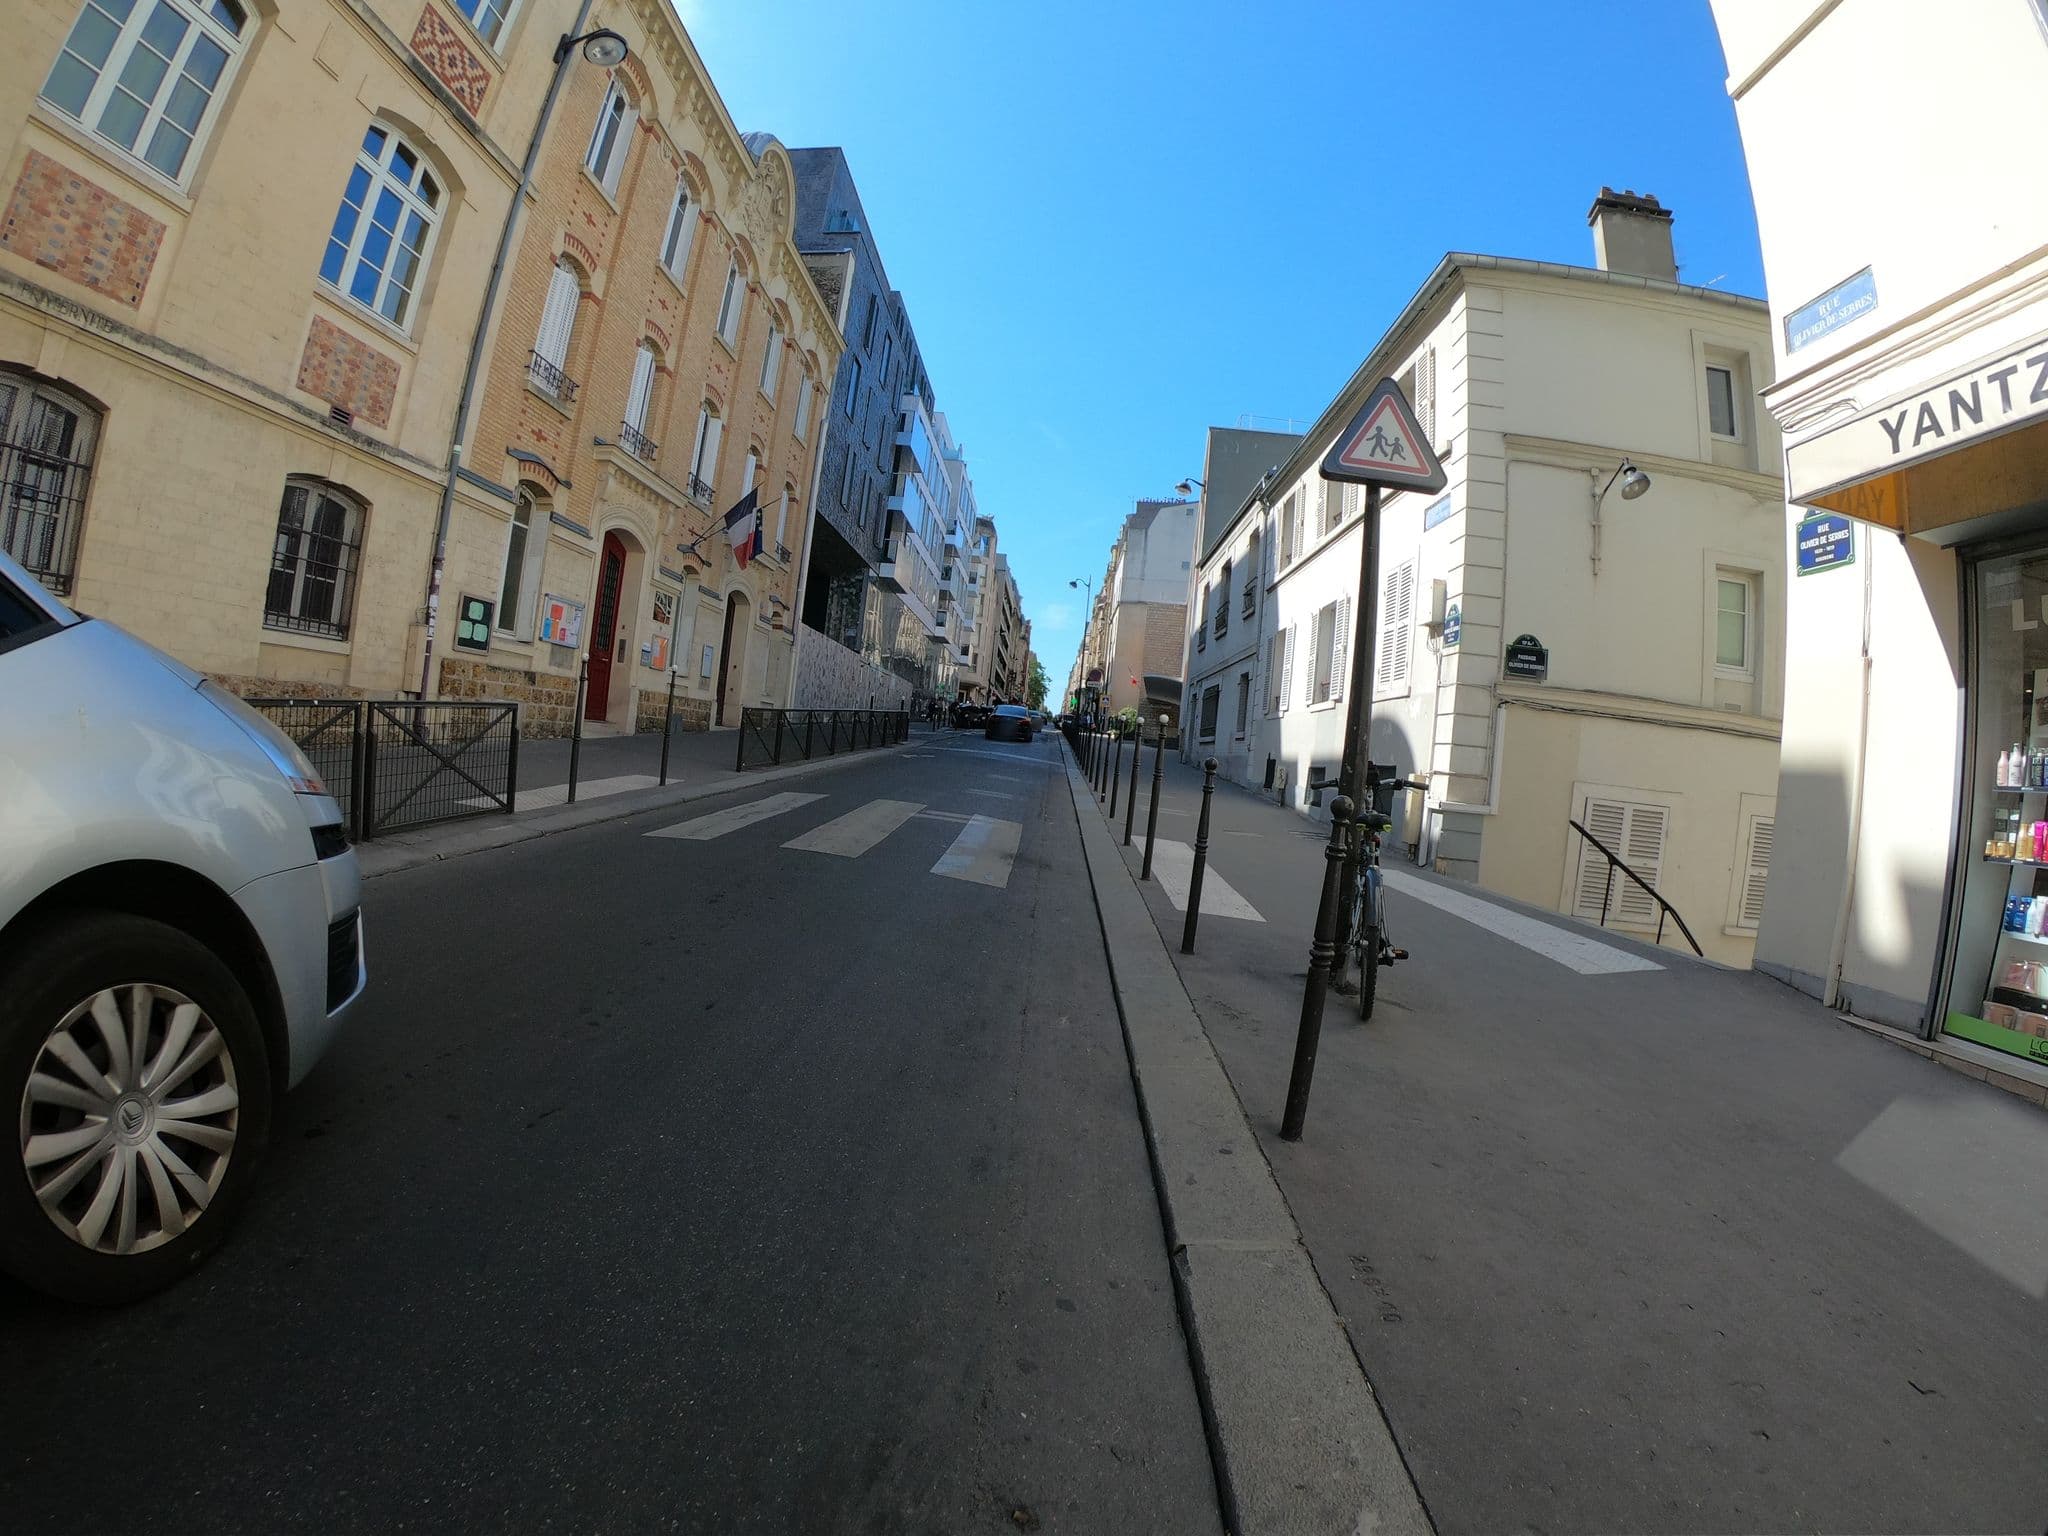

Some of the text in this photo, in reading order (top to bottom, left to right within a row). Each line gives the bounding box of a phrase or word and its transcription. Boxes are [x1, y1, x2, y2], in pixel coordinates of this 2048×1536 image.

[1818, 294, 1841, 317] RUE
[1793, 292, 1873, 346] OLIVIER DE SERRES
[1817, 522, 1830, 534] RUE
[1800, 537, 1820, 550] OLIVIER
[1819, 534, 1828, 545] DE
